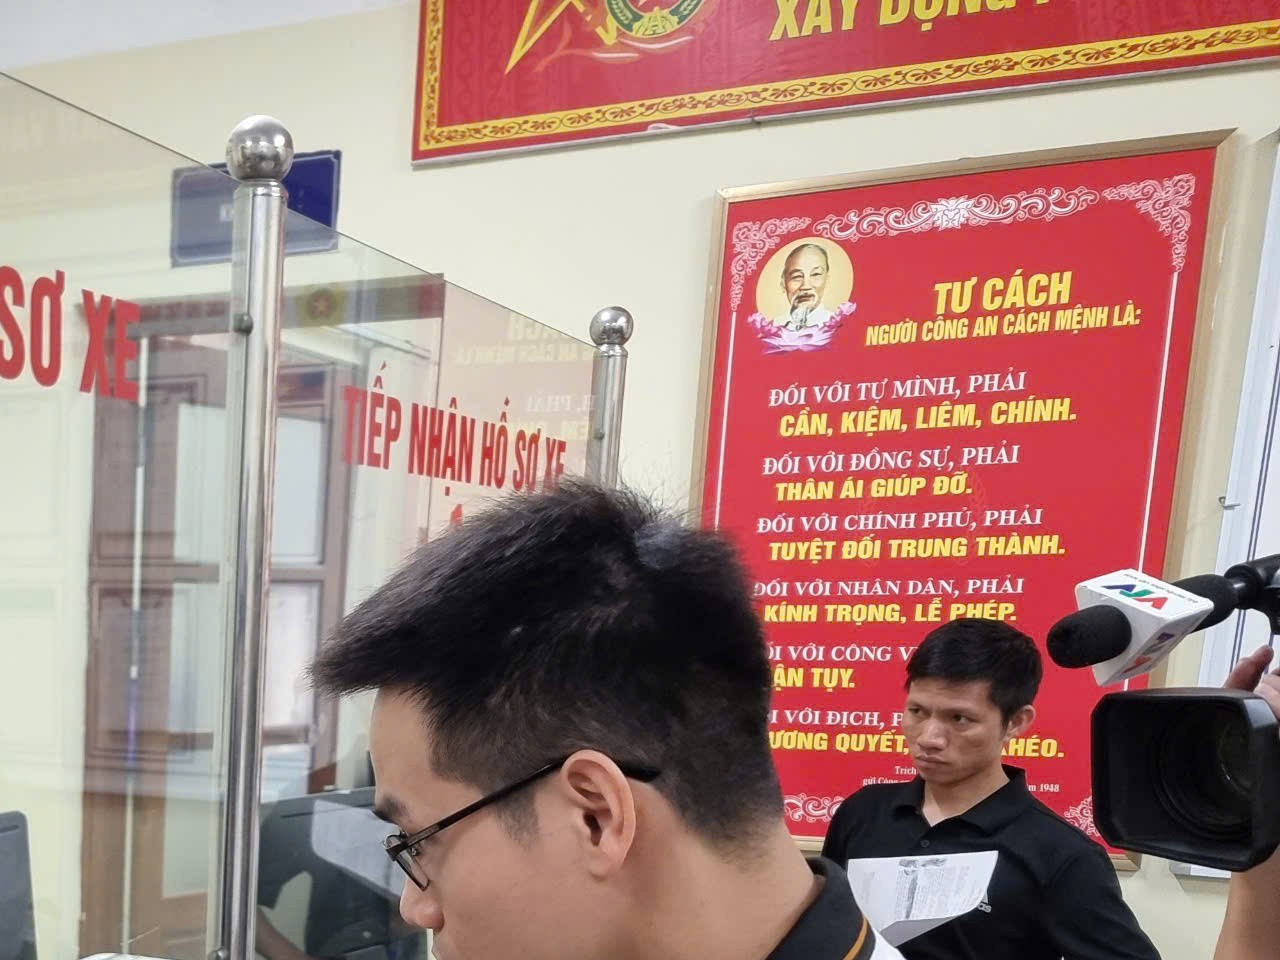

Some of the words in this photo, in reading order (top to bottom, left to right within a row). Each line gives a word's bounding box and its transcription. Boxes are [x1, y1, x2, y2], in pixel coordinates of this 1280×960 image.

[934, 276, 977, 315] TƯ
[983, 269, 1072, 312] CÁCH
[865, 321, 918, 346] NGƯỜI
[921, 316, 968, 343] CÔNG
[973, 314, 997, 338] AN
[1003, 309, 1051, 335] CÁCH
[1055, 304, 1108, 335] MỆNH
[1112, 300, 1141, 327] LÀ:
[79, 288, 140, 401] XE
[769, 383, 806, 407] ĐỐI
[813, 378, 850, 404] VỚI
[857, 379, 885, 403] TỰ
[891, 373, 960, 400] MÌNH,
[969, 367, 1027, 394] PHẢI
[344, 361, 402, 470] TIẾP
[408, 397, 475, 496] NHẬN
[479, 397, 508, 489] HỒ
[513, 428, 541, 492] SƠ
[542, 437, 566, 494] XE
[779, 404, 834, 437] CẦN,
[841, 405, 908, 437] KIỆM,
[915, 401, 981, 431] LIÊM,
[990, 393, 1077, 424] CHÍNH.
[763, 451, 800, 476] ĐỐI
[806, 447, 844, 473] VỚI
[849, 447, 912, 472] ĐỒNG
[919, 445, 954, 471] SỰ,
[962, 440, 1020, 465] PHẢI
[775, 476, 834, 501] THÂN
[840, 475, 864, 499] ÁI
[870, 473, 926, 498] GIÚP
[933, 470, 972, 495] ĐỠ.
[756, 513, 793, 533] ĐỐI
[801, 512, 838, 532] VỚI
[844, 509, 916, 531] CHÍNH
[922, 506, 976, 530] PHỦ,
[983, 505, 1043, 527] PHẢI
[769, 537, 836, 564] TUYỆT
[841, 533, 882, 560] ĐỐI
[888, 537, 968, 558] TRUNG
[976, 532, 1066, 556] THÀNH.
[754, 578, 789, 597] ĐỐI
[794, 578, 832, 596] VỚI
[837, 578, 900, 597] NHÂN
[907, 577, 960, 599] DÂN,
[967, 574, 1024, 595] PHẢI
[764, 601, 818, 622] KÍNH
[825, 603, 906, 626] TRỌNG,
[914, 596, 941, 622] LỄ
[950, 600, 1017, 622] PHÉP.
[788, 642, 825, 661] VỚI
[831, 643, 892, 662] CÔNG
[773, 663, 804, 691] ẬN
[811, 667, 856, 692] TỤY.
[784, 707, 821, 724] VỚI
[826, 711, 885, 729] ĐỊCH,
[769, 729, 828, 750] ƯƠNG
[835, 729, 909, 755] QUYẾT,
[1000, 735, 1065, 758] HÉO.
